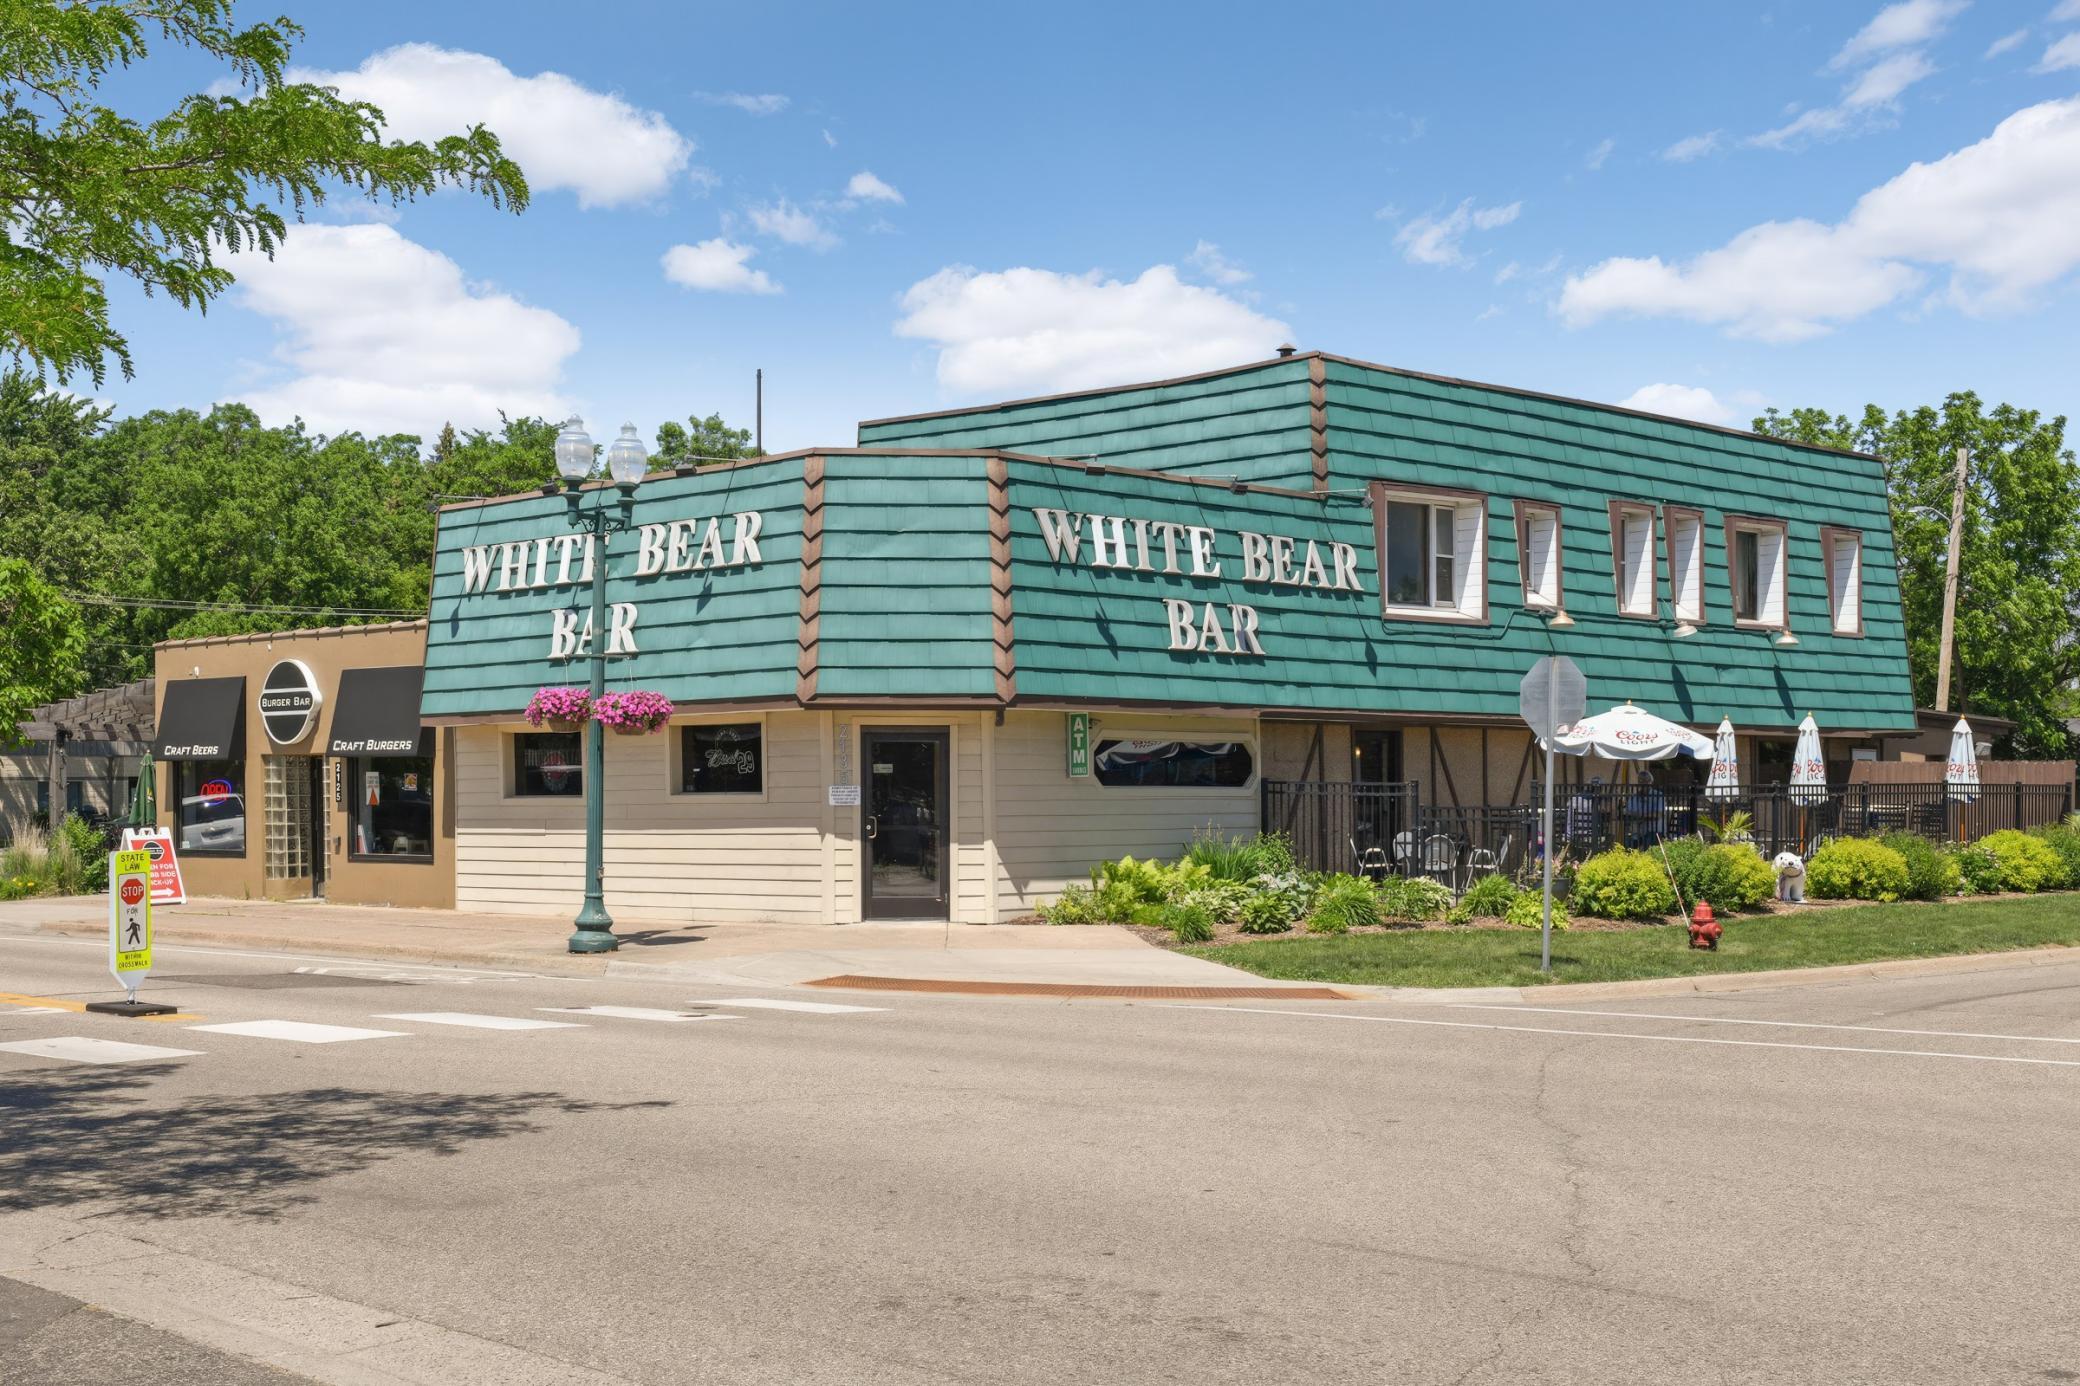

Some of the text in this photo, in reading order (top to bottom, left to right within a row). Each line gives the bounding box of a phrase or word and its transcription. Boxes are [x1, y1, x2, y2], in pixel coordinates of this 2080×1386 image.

[633, 511, 763, 577] BEAR
[1031, 508, 1365, 592] WHITE BEAR
[1163, 599, 1266, 656] BAR
[262, 697, 311, 708] BURGER BAR
[333, 739, 413, 751] CRAFT BURGERS
[1073, 717, 1085, 764] ATM
[164, 744, 219, 756] CRAFT BEERS
[201, 784, 228, 800] OPEN
[120, 853, 145, 863] STATE
[122, 886, 145, 897] STOP
[127, 907, 138, 915] FOR
